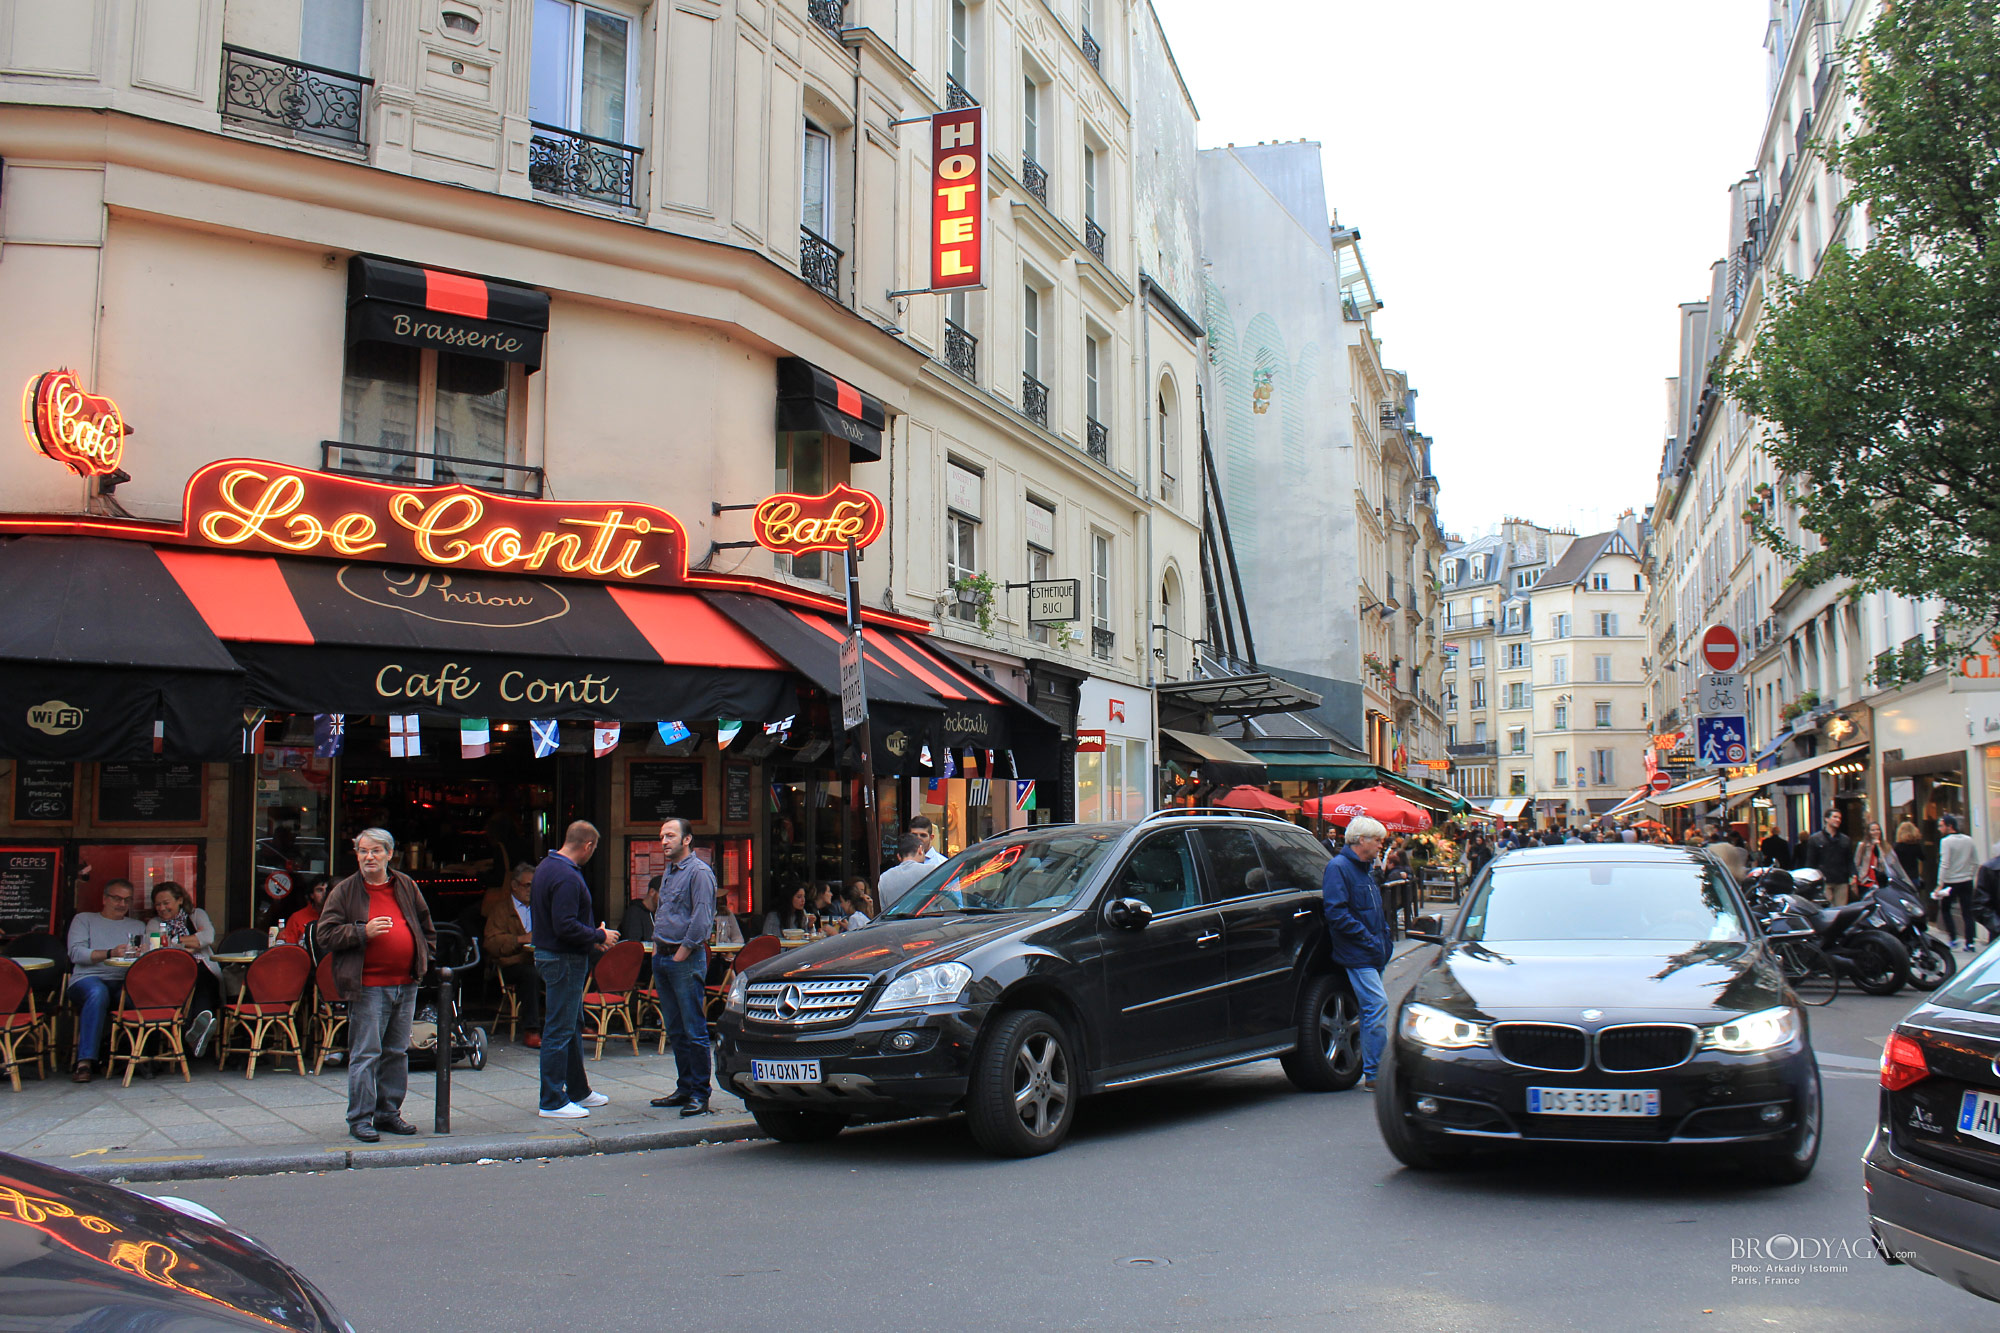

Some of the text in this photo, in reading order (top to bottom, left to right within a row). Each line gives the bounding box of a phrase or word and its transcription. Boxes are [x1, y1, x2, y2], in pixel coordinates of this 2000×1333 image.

[938, 121, 976, 277] HOTEL
[393, 314, 523, 352] Brasserie
[841, 420, 864, 441] Pub
[199, 468, 675, 578] Le Conti
[383, 568, 533, 607] Philou
[1032, 585, 1073, 599] ESTHETIQUE
[1042, 602, 1062, 614] BUCI
[375, 663, 620, 706] Café Conti
[1710, 677, 1734, 687] SAUF
[943, 712, 989, 736] ocktails
[1077, 735, 1102, 746] CAMPER
[1730, 749, 1742, 757] 20
[23, 778, 73, 790] Hamburger
[28, 790, 62, 798] maison
[1334, 803, 1369, 816] Coca-Cola
[10, 857, 47, 867] CREPES
